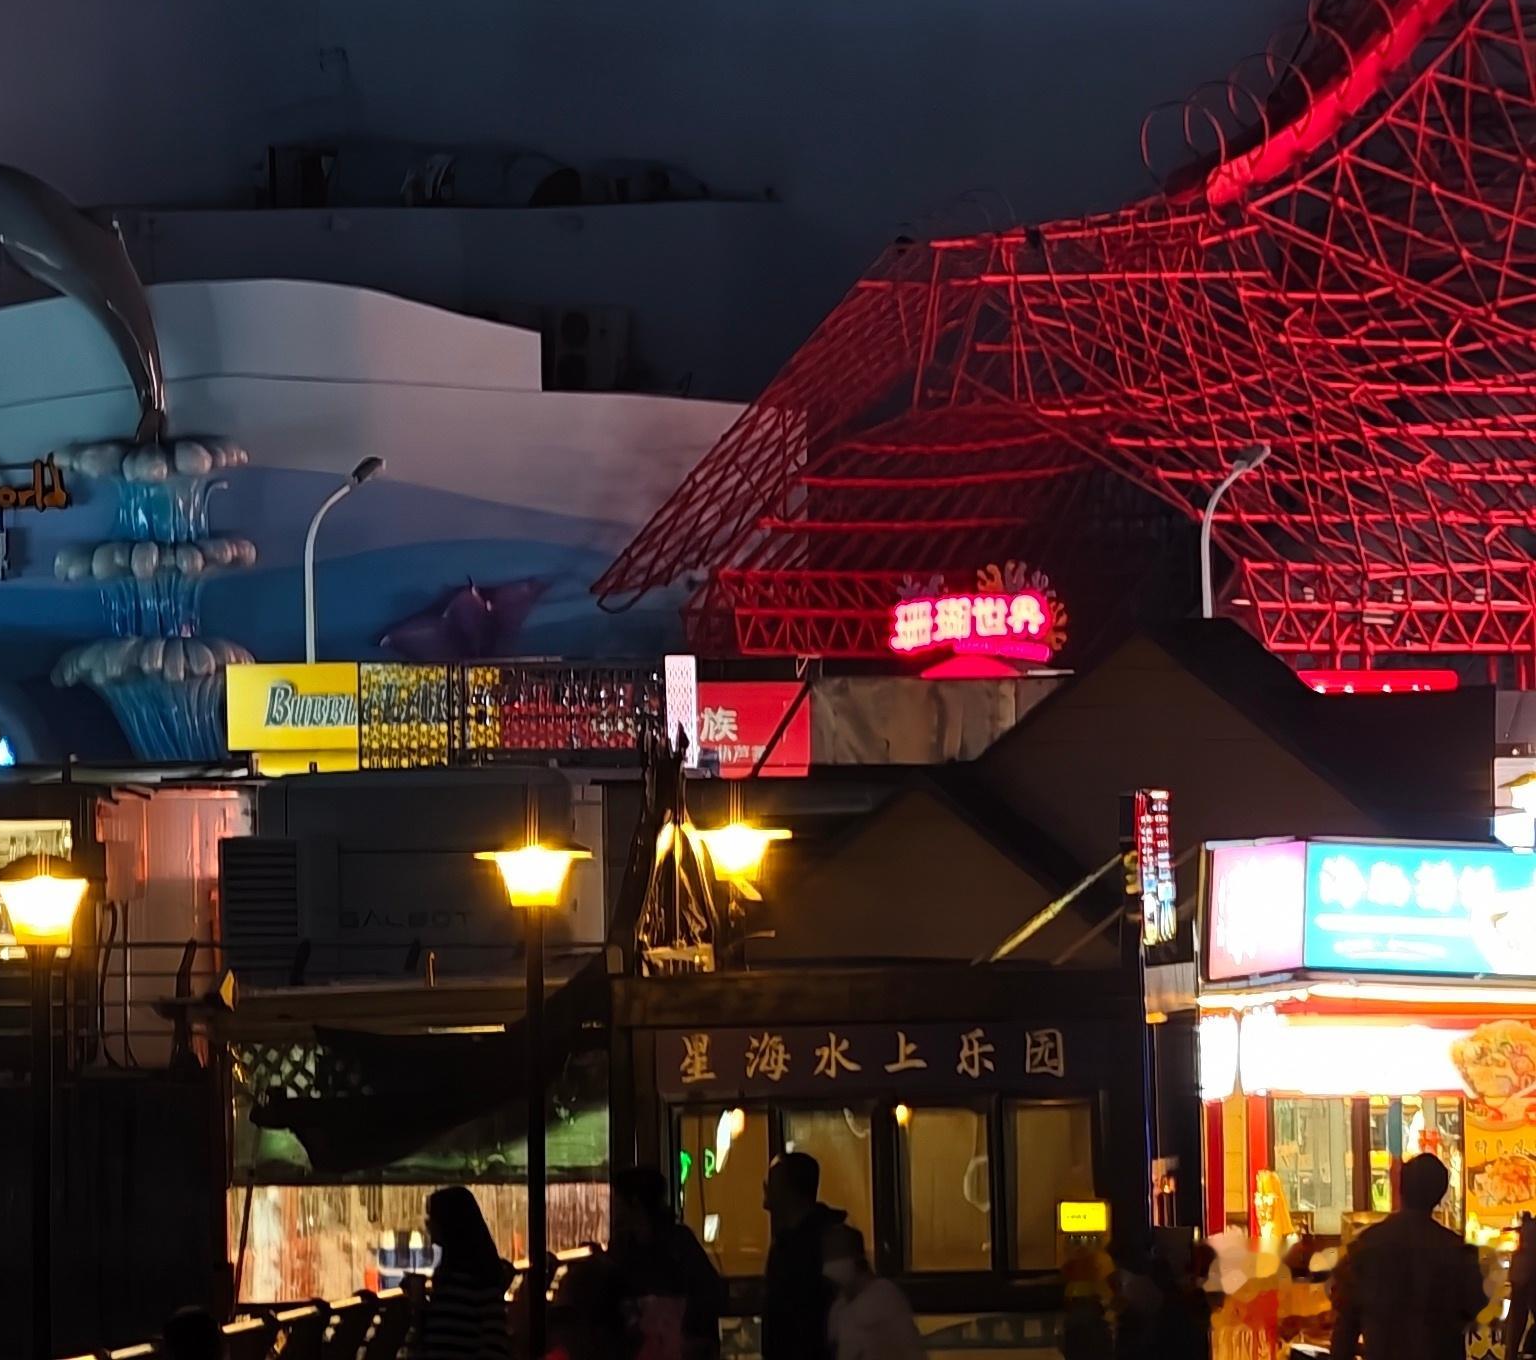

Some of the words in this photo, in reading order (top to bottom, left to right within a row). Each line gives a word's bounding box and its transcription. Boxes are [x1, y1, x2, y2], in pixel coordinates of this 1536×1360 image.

[681, 1028, 1065, 1082] 星海水上乐园
